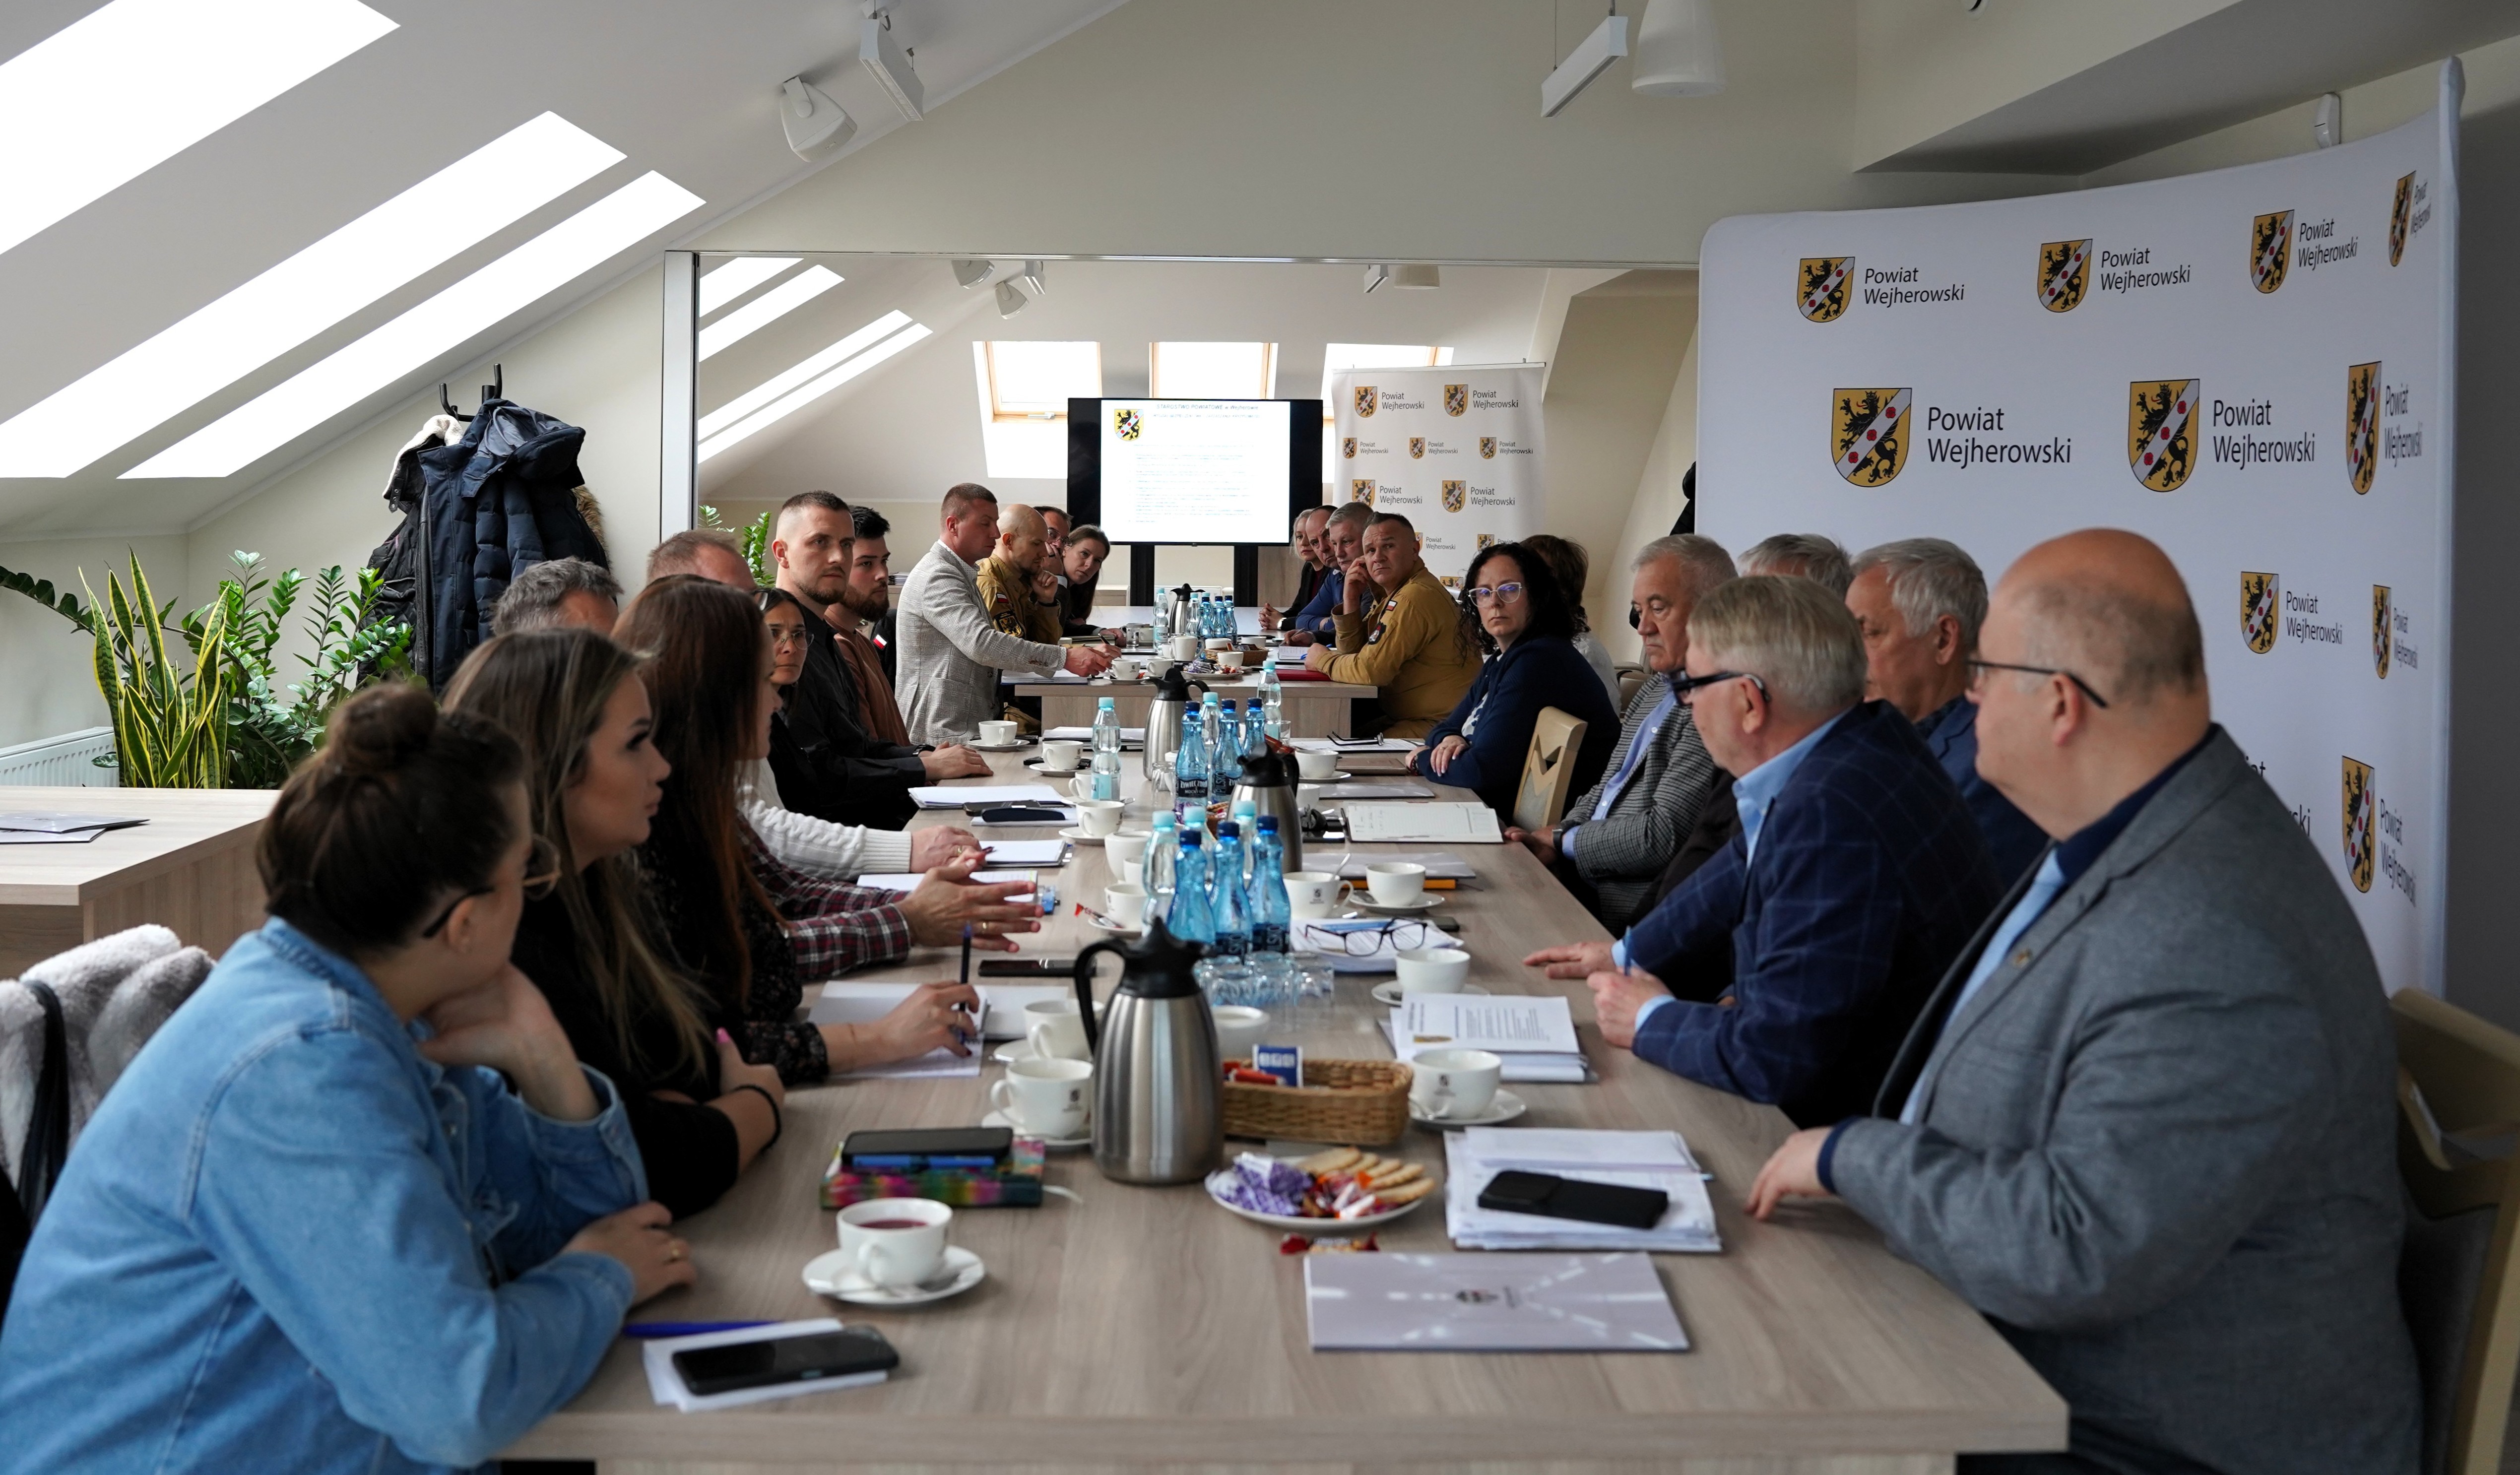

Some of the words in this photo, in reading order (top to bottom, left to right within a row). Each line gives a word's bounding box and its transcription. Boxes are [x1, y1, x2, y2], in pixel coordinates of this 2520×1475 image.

[2299, 218, 2334, 242] Powiat
[2101, 248, 2150, 268] Powiat
[2298, 236, 2358, 270] Wejherowski
[1865, 267, 1919, 284] Powiat
[2101, 264, 2191, 294] Wejherowski
[1865, 284, 1965, 308] Wejherowski
[1382, 401, 1424, 411] Wejherowski
[1473, 399, 1519, 409] Wejherowski
[2385, 383, 2409, 417] Powiat
[1928, 406, 2004, 431] Powiat
[2213, 398, 2272, 427] Powiat
[1928, 436, 2071, 467] Wejherowski
[2213, 432, 2316, 471] Wejherowski
[1380, 485, 1402, 494] Powiat
[1380, 496, 1423, 506] Wejherowski
[1471, 487, 1495, 495] Powiat
[1471, 497, 1515, 507] Wejherowski
[2286, 591, 2318, 614] Powiat
[2286, 616, 2342, 644] Wejherowski
